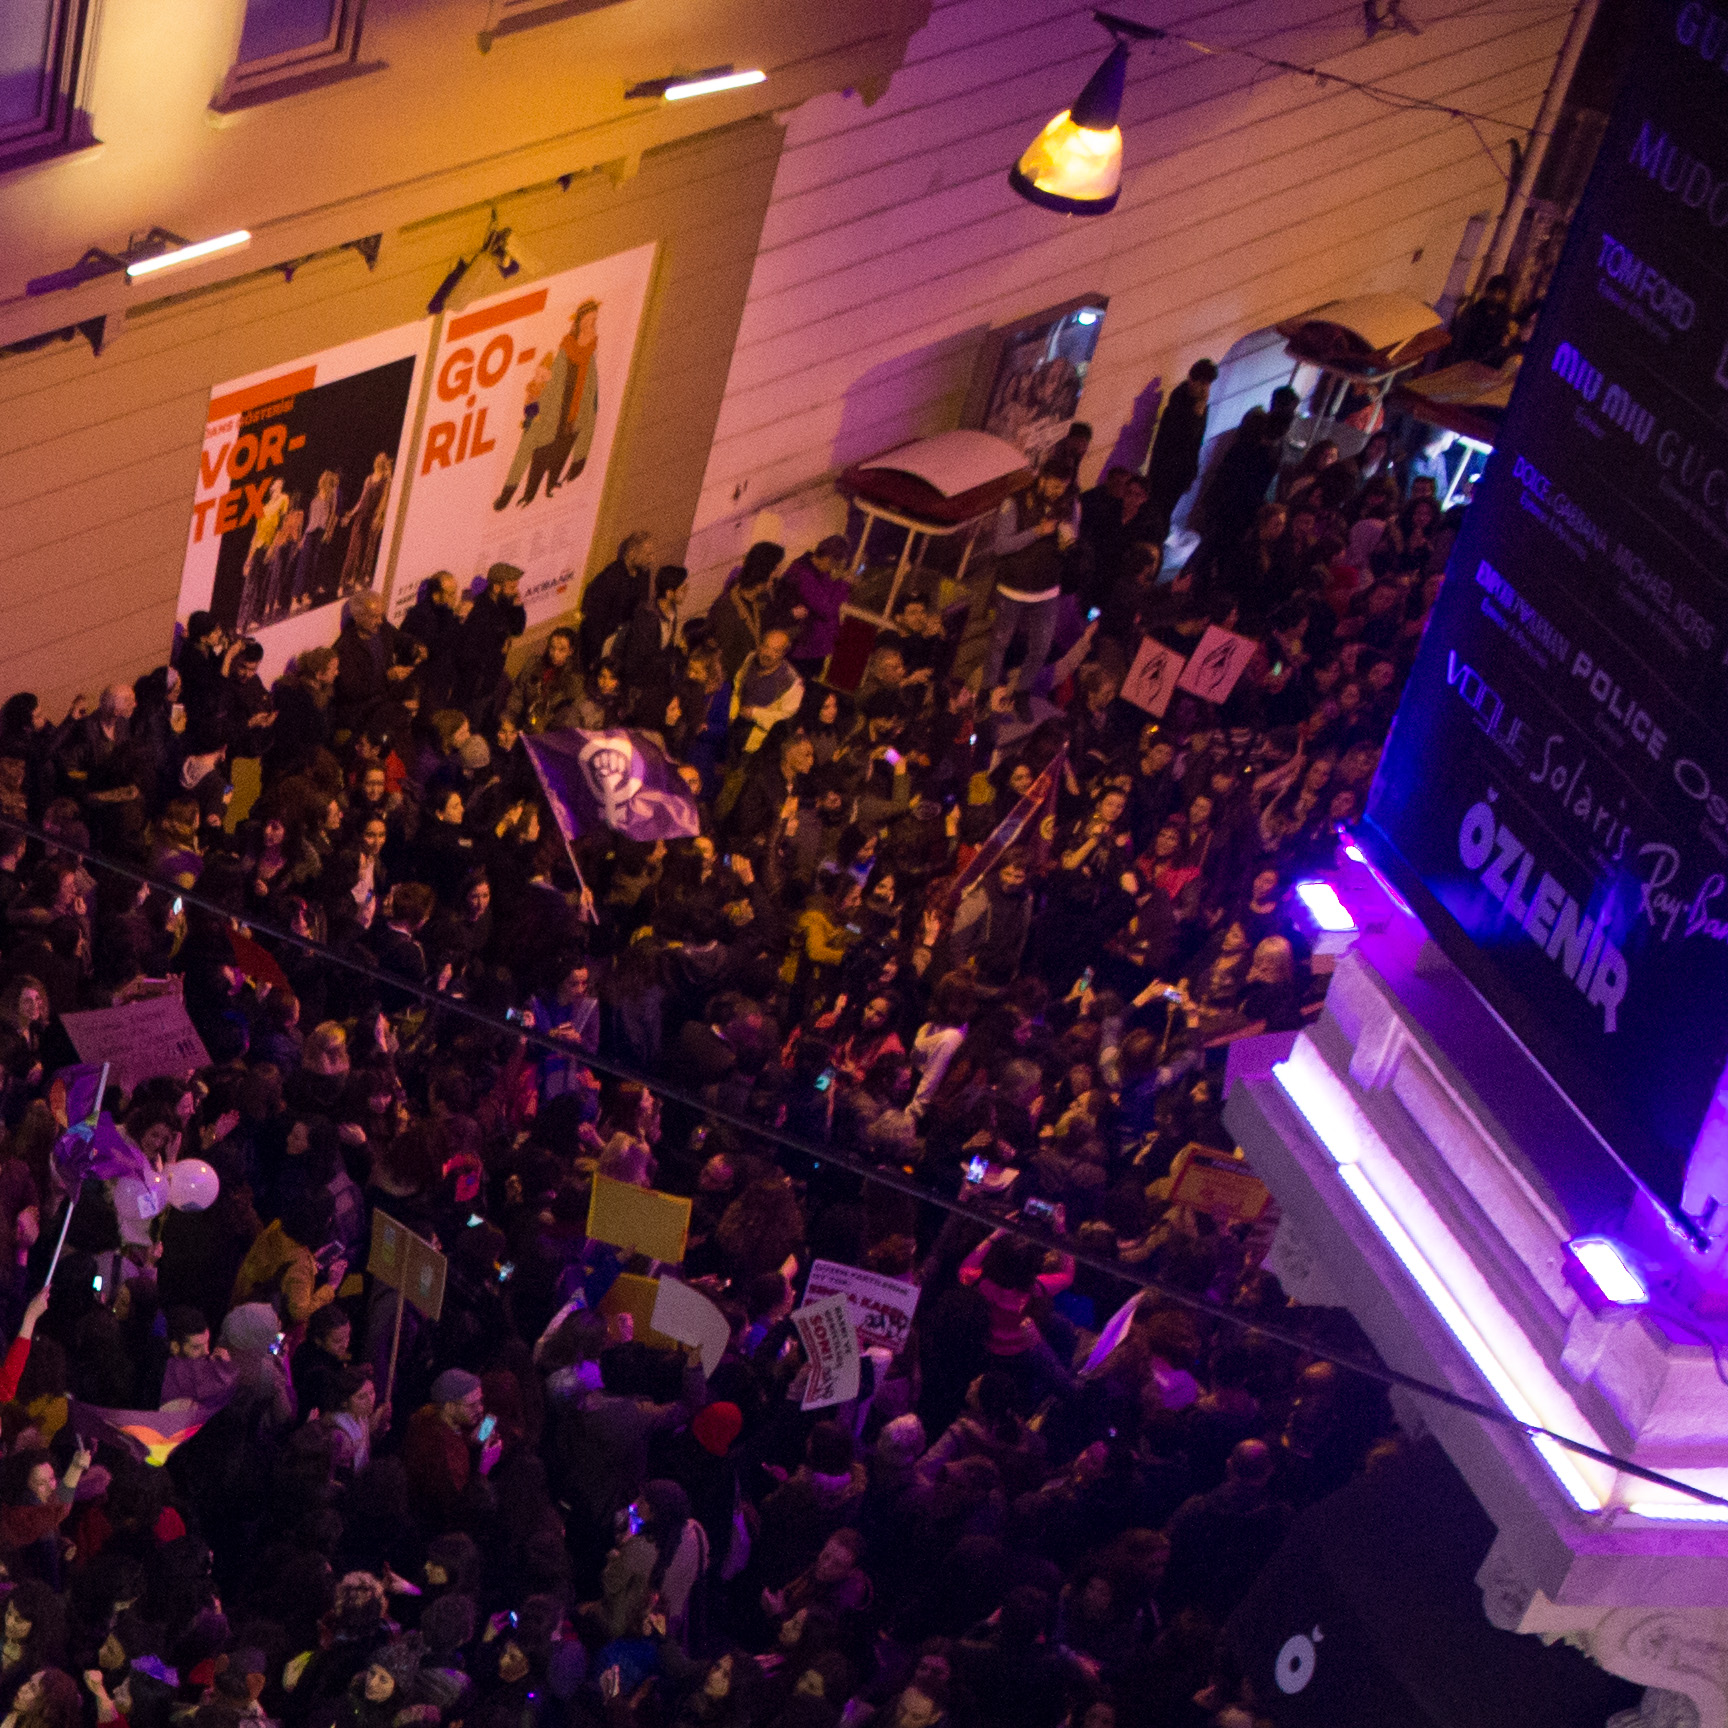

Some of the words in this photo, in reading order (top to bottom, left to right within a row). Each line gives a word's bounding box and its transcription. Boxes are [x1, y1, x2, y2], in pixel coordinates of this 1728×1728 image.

[437, 334, 536, 402] GO-
[200, 424, 306, 490] VOR-
[421, 395, 496, 477] RİL
[193, 476, 274, 544] TEX
[1572, 651, 1669, 761] POLICE
[1530, 735, 1632, 861] Solaris
[1459, 787, 1628, 1034] ÖZLENİR
